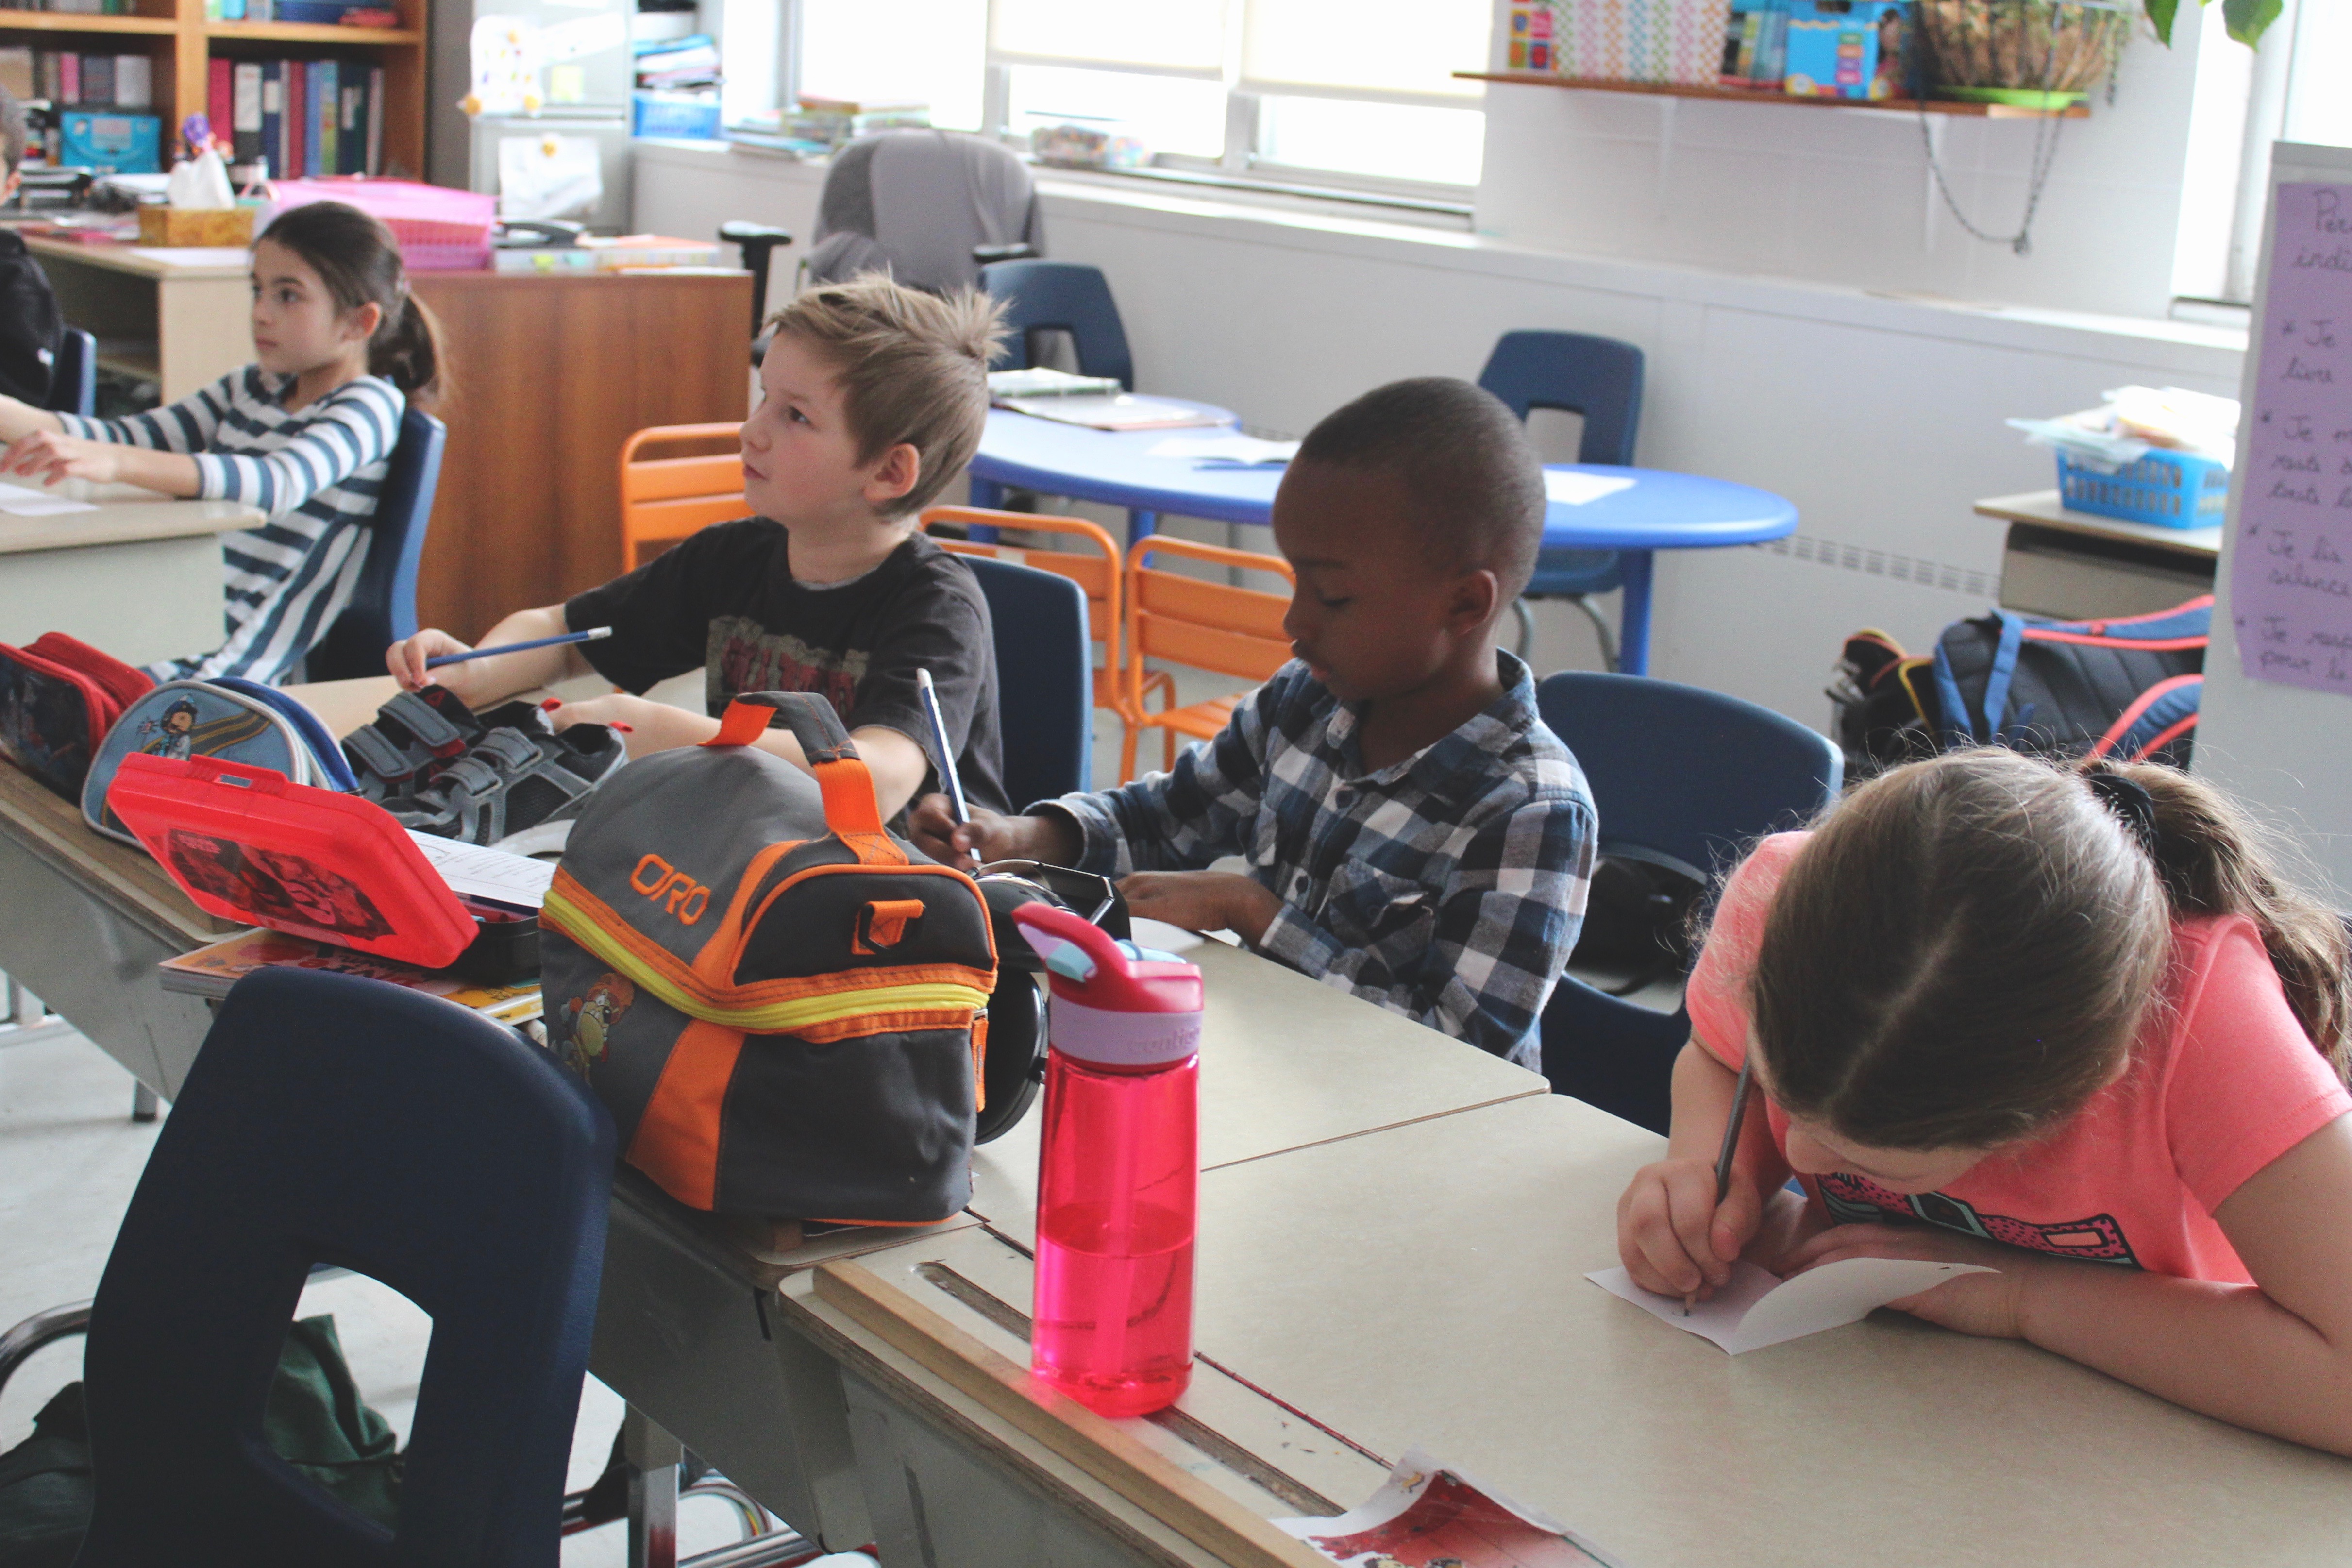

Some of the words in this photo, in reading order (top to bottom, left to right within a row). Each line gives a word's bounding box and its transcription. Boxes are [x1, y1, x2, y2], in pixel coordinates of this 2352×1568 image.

[2305, 319, 2336, 347] Je
[2283, 415, 2313, 441] Je
[2267, 529, 2294, 559] Je
[2262, 616, 2286, 642] Je
[630, 853, 711, 925] ORO
